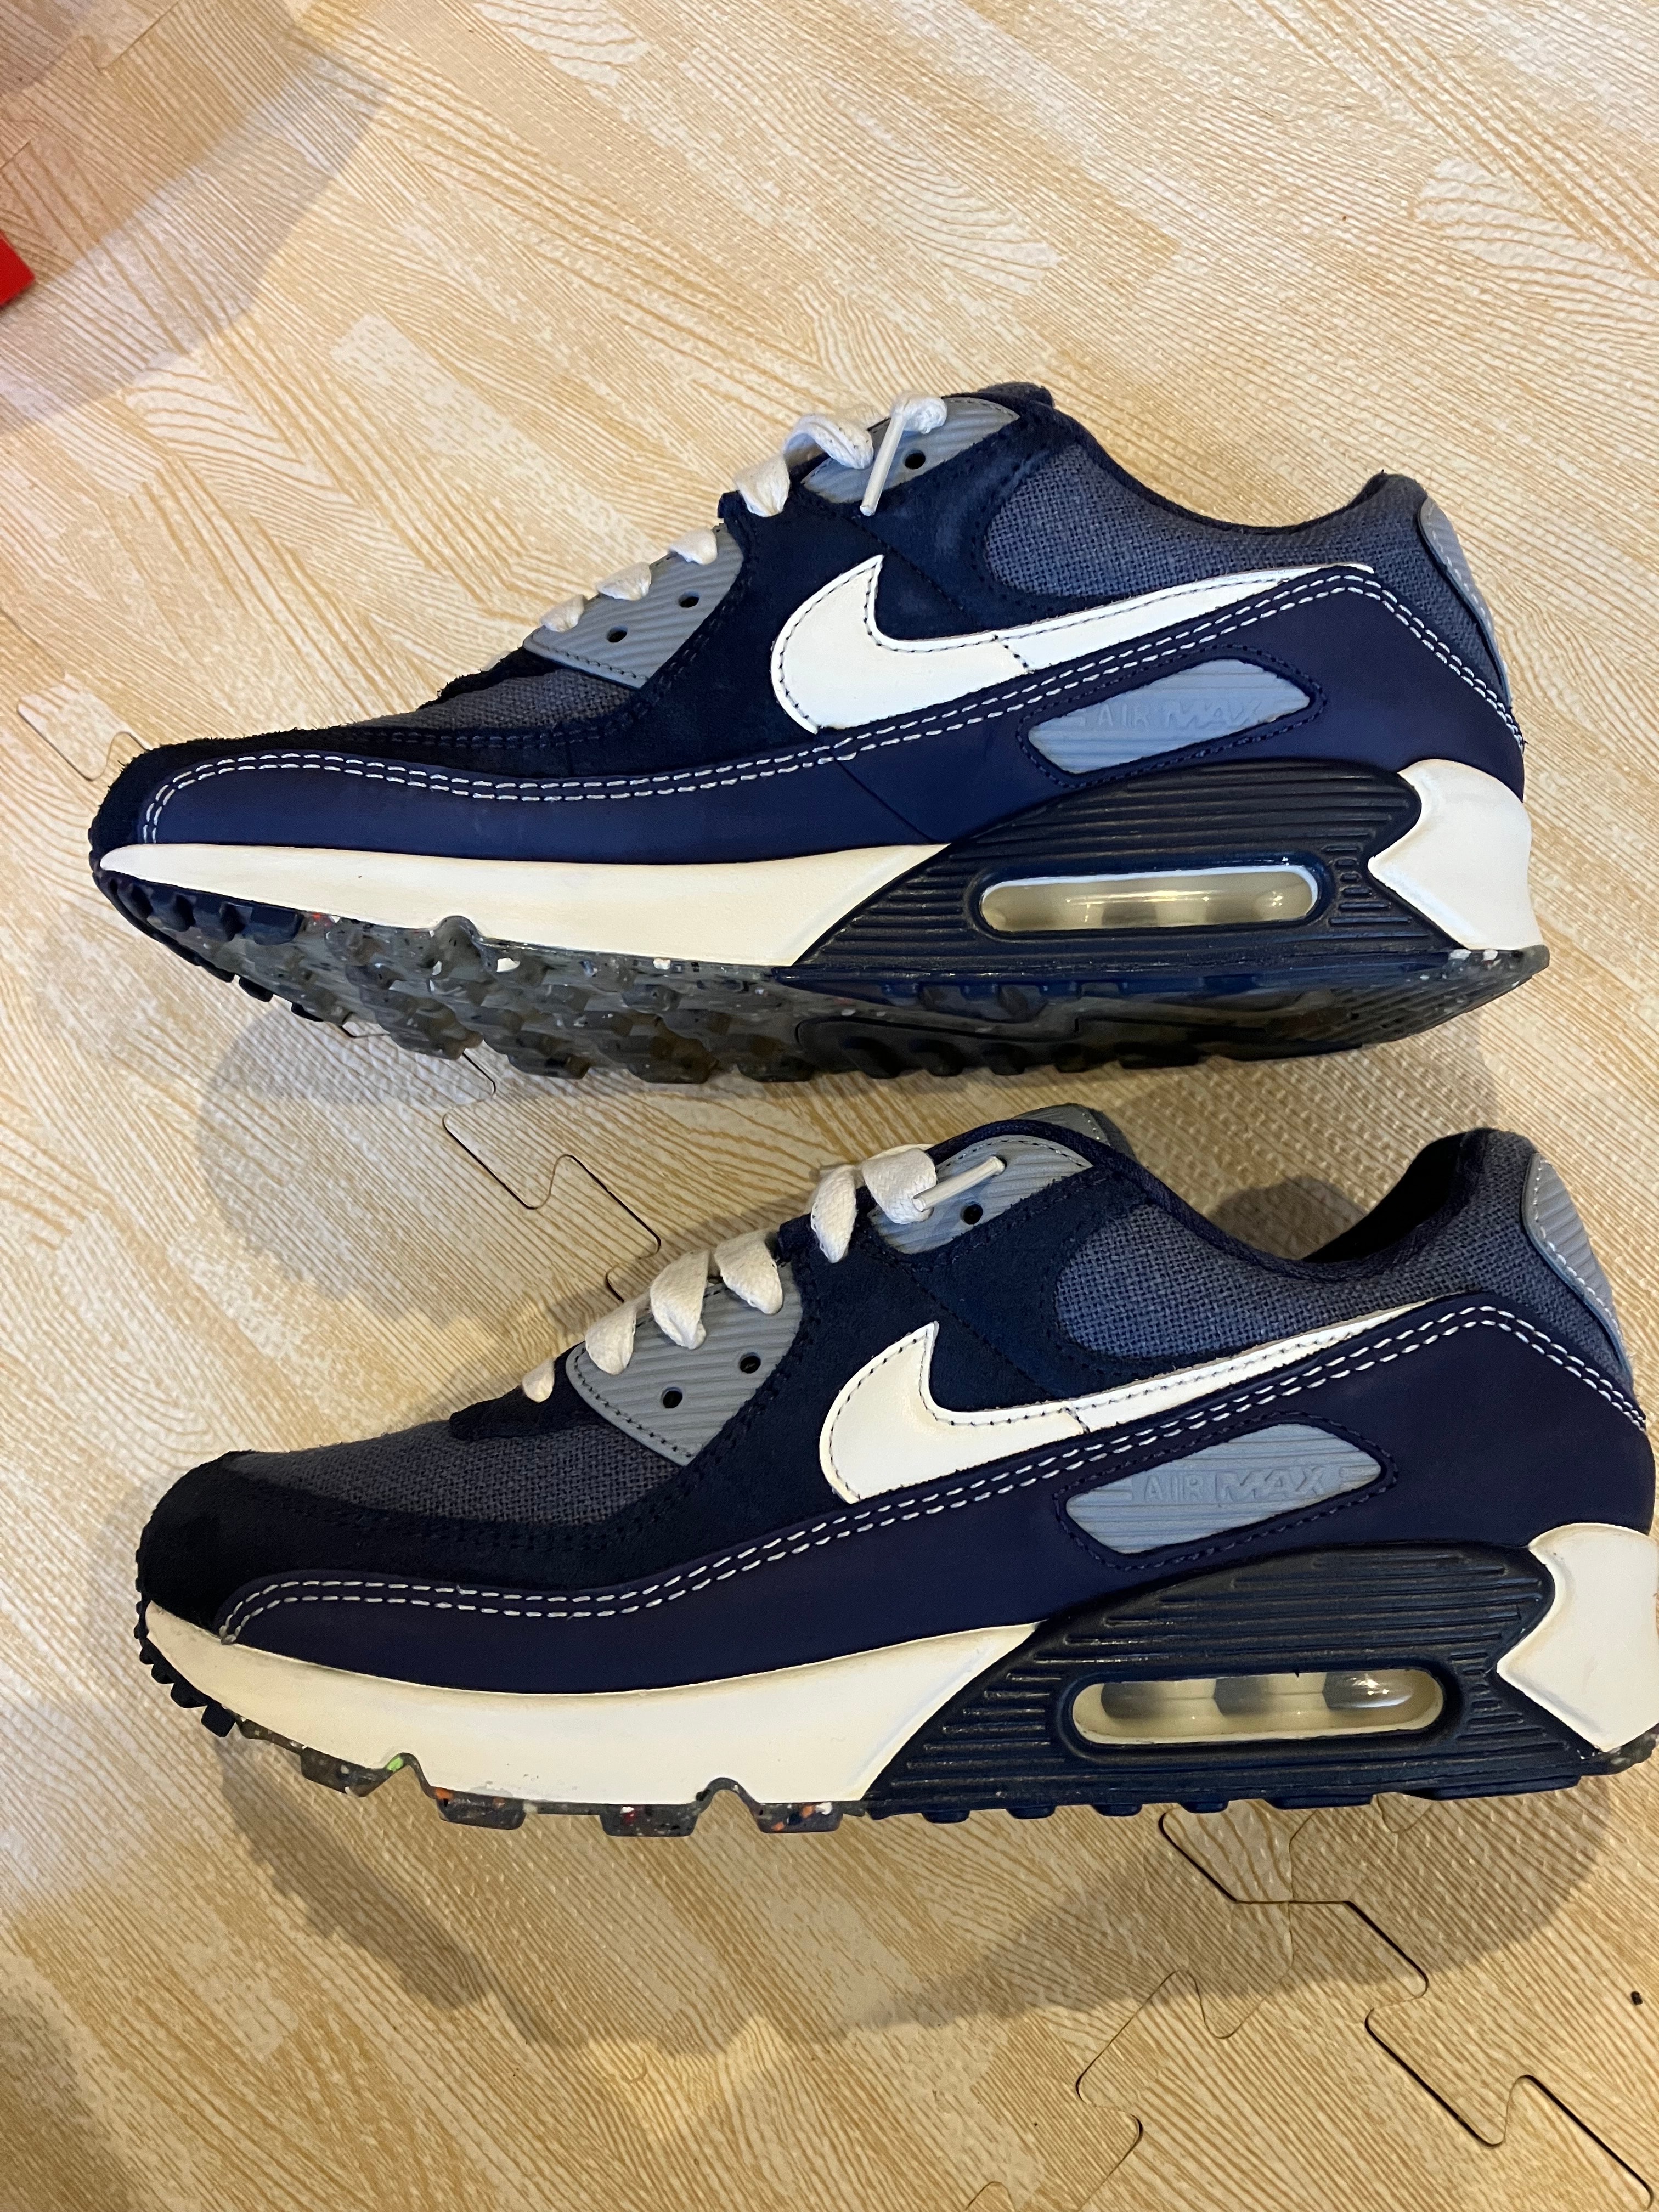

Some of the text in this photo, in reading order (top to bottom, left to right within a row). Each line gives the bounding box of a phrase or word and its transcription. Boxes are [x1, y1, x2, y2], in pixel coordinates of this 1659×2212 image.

[1098, 702, 1150, 729] AIR
[1143, 1466, 1325, 1502] AIR MAX
